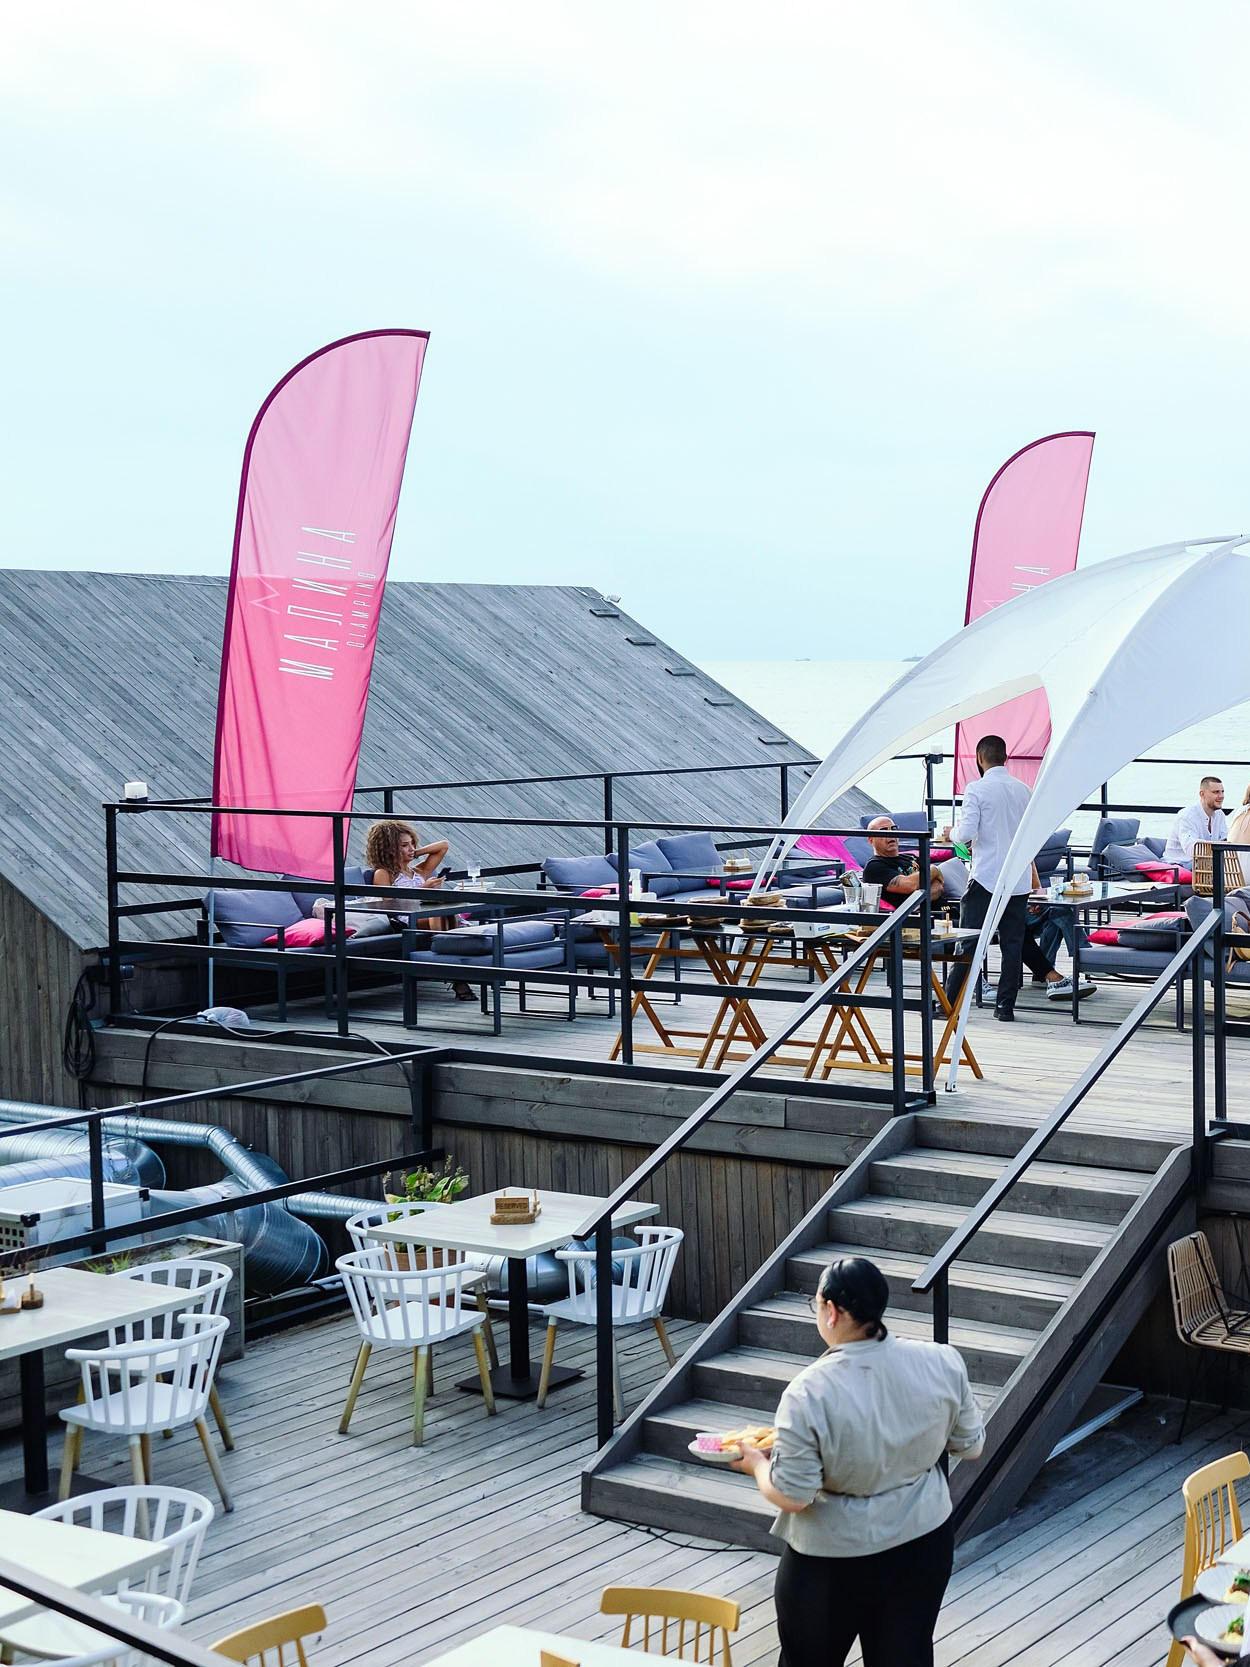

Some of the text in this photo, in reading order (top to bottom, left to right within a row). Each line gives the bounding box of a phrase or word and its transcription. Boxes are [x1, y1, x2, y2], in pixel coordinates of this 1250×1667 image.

[278, 526, 356, 681] МАЛИНА
[346, 571, 377, 648] GLAMPING
[496, 1202, 528, 1210] RESERVED
